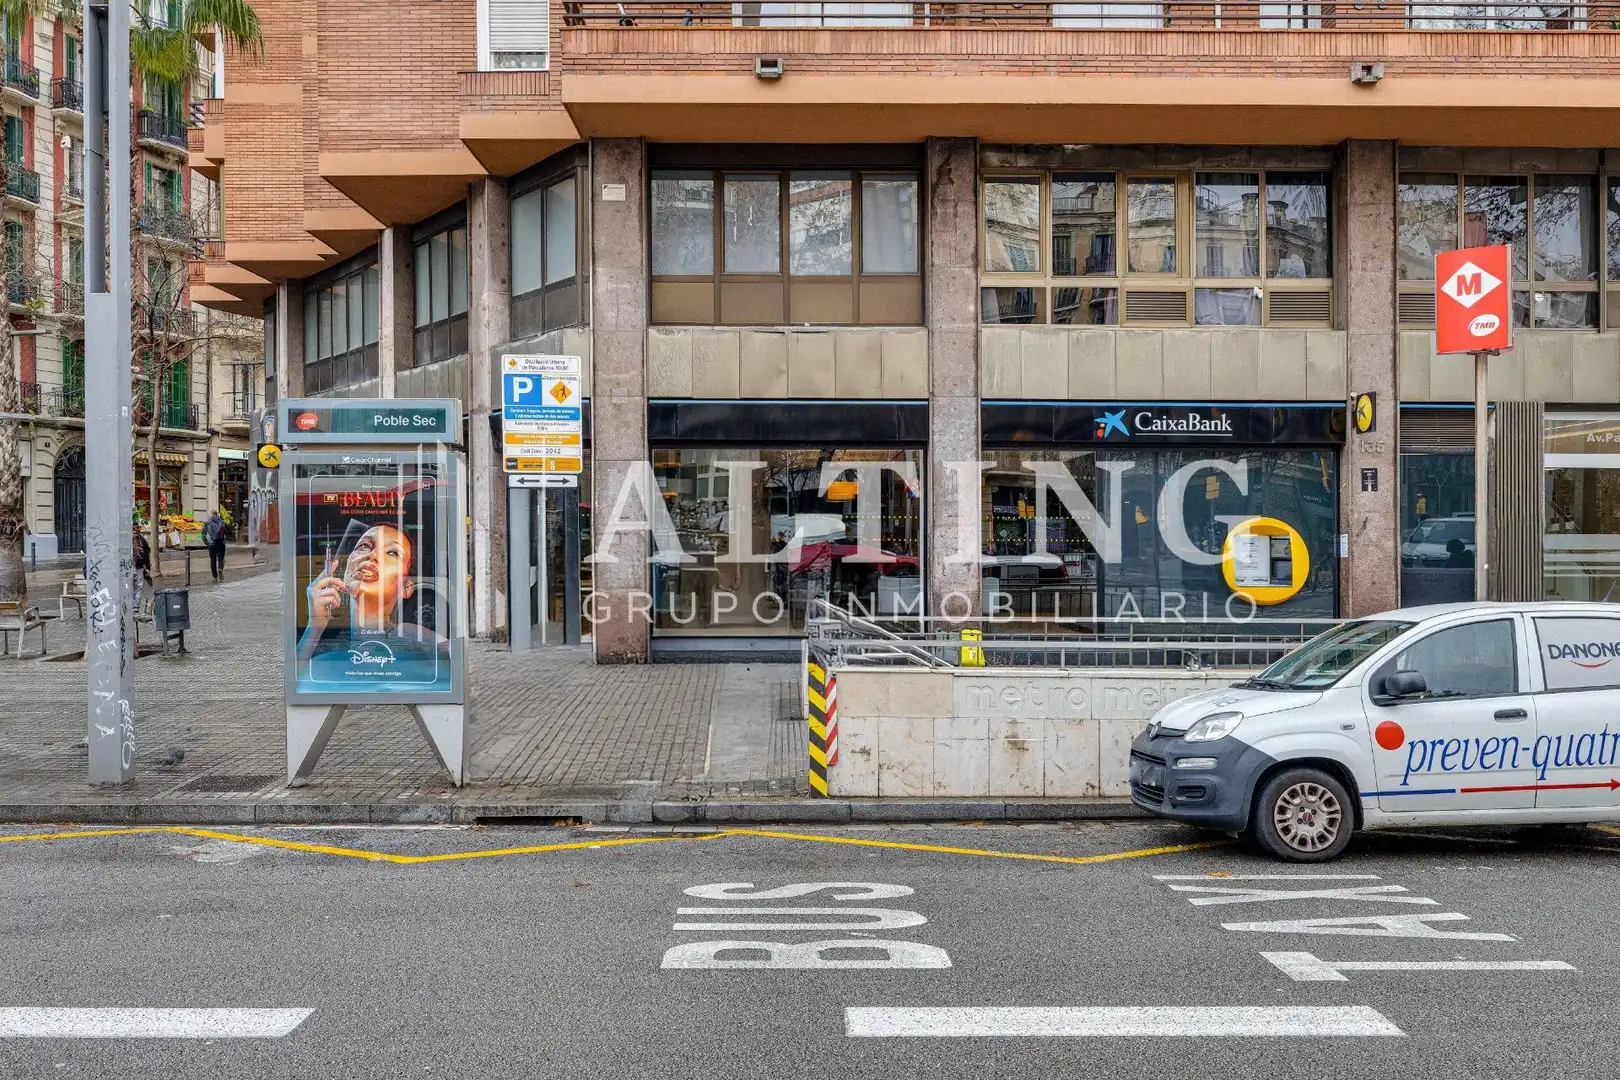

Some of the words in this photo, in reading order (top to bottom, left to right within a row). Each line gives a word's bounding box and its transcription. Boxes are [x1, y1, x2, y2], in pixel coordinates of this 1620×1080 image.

[1456, 272, 1482, 297] M
[1474, 321, 1497, 331] TMB
[512, 376, 533, 403] P
[300, 417, 316, 426] TMB
[374, 415, 410, 427] Poble
[413, 415, 437, 427] Sec
[1134, 411, 1233, 432] CaixaBank
[341, 490, 407, 508] BEAUTY
[964, 681, 1090, 712] metro
[660, 880, 954, 970] BUS
[1151, 873, 1578, 983] TAXI
